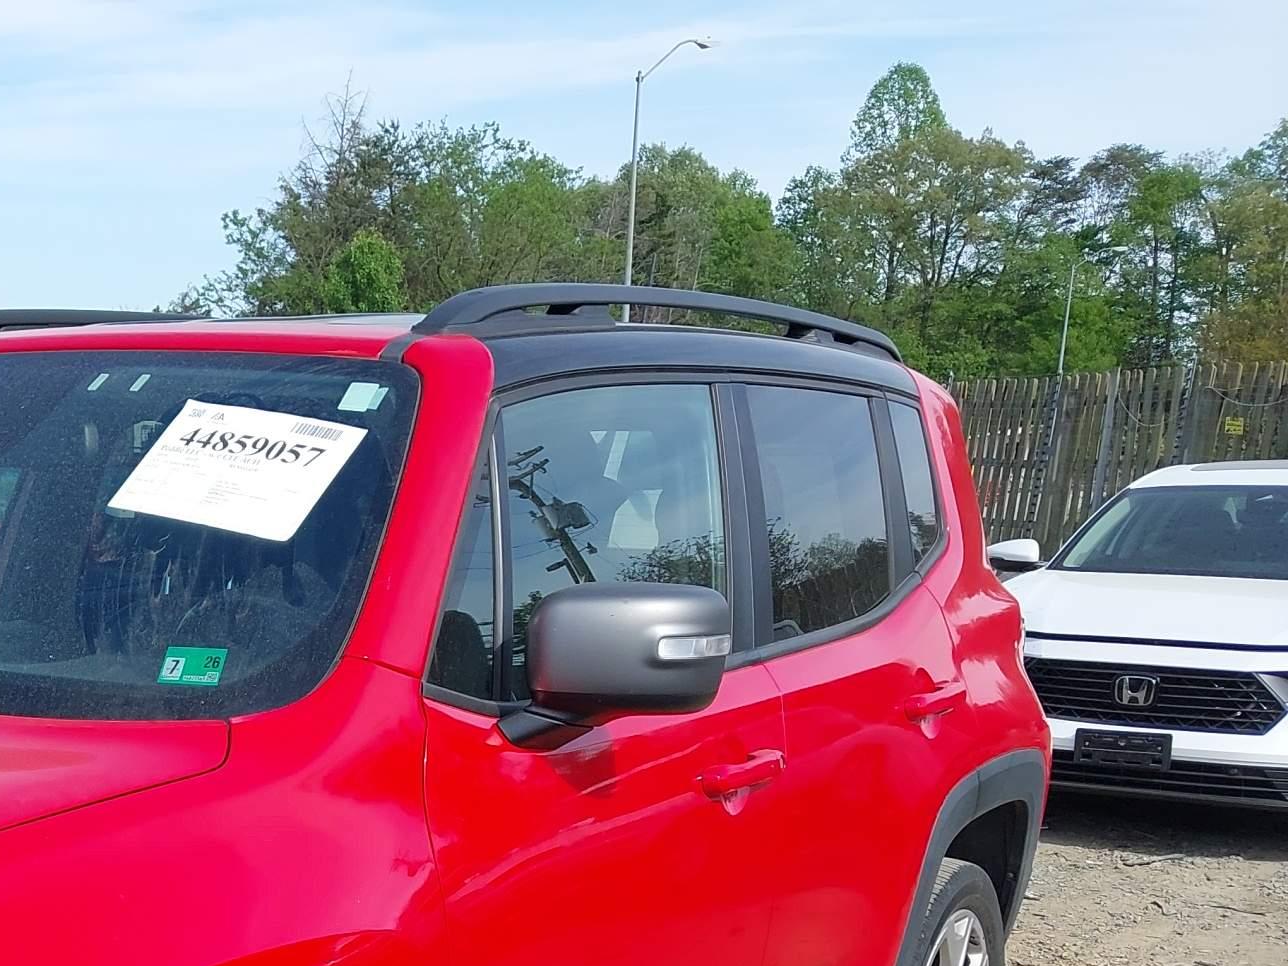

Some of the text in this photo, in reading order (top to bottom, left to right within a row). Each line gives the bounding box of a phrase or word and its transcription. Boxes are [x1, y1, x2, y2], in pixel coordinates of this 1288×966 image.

[179, 427, 326, 467] 44859057
[168, 655, 221, 674] 7 26
